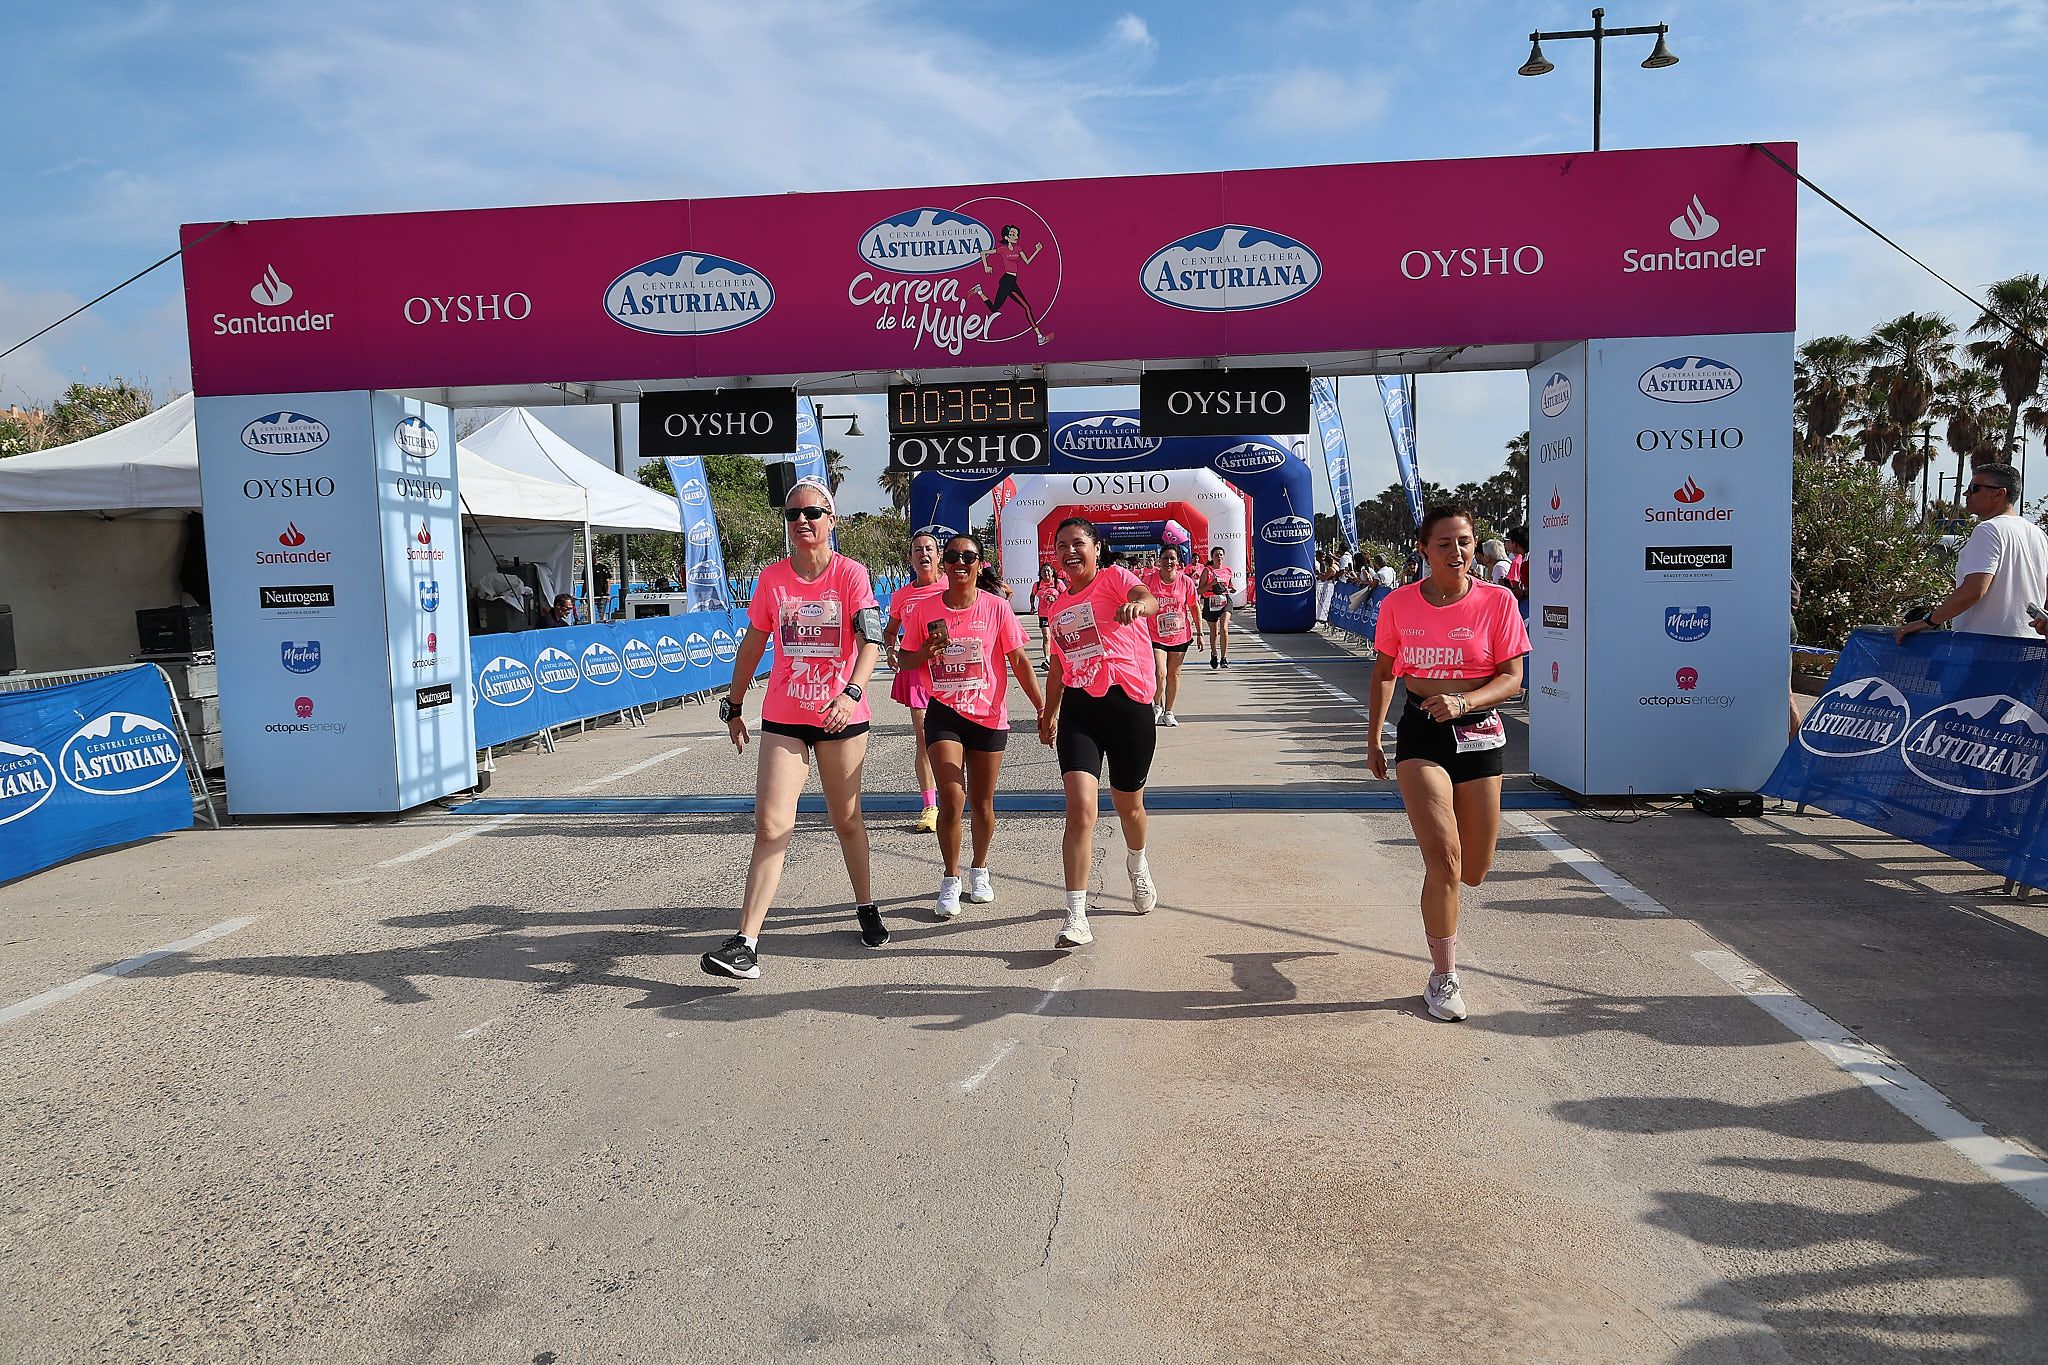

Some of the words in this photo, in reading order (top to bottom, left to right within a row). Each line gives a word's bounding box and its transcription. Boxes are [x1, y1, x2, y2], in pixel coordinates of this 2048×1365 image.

[889, 230, 933, 239] CENTRAL
[935, 228, 979, 237] LECHERA
[868, 234, 983, 259] ASTURIANA
[1181, 255, 1238, 266] CENTRAL
[1244, 252, 1301, 262] LECHERA
[1400, 245, 1545, 280] OYSHO
[1623, 244, 1766, 273] Santander
[642, 281, 694, 291] CENTRAL
[701, 278, 755, 288] LECHERA
[1154, 260, 1308, 292] ASTURIANA
[848, 271, 960, 305] Carrera
[403, 292, 532, 326] OYSHO
[618, 285, 762, 315] ASTURIANA
[213, 311, 334, 335] Santander
[876, 306, 897, 330] de
[901, 305, 916, 330] la
[913, 297, 1002, 356] Mujer
[1646, 374, 1735, 392] ASTURIANA
[899, 386, 1035, 425] 00:36:32
[1167, 390, 1286, 415] OYSHO
[664, 411, 774, 437] OYSHO
[248, 428, 324, 445] ASTURIANA
[398, 428, 436, 450] ASTURIANA
[1062, 430, 1155, 450] ASTURIANA
[1636, 427, 1744, 451] OYSHO
[897, 433, 1042, 467] OYSHO
[1540, 436, 1572, 464] OYSHO
[1221, 453, 1282, 468] ASTURIANA
[243, 476, 335, 499] OYSHO
[396, 477, 443, 500] OYSHO
[1072, 473, 1170, 496] OYSHO
[1016, 499, 1045, 507] OYSHO
[1197, 491, 1227, 500] OYSHO
[1083, 503, 1111, 513] Sports
[1123, 501, 1168, 510] Santander
[1645, 507, 1733, 523] Santander
[1005, 538, 1032, 546] OYSHO
[1265, 526, 1312, 538] ASTURIANA
[256, 550, 331, 565] Santander
[406, 547, 445, 561] Santander
[1651, 551, 1727, 568] Neutrogena
[264, 590, 330, 605] Neutrogena
[798, 626, 822, 636] 016
[1667, 613, 1709, 633] Marlene
[283, 647, 320, 666] Marlene
[1403, 647, 1464, 665] CARRERA
[540, 667, 579, 684] ASTURIANA
[585, 660, 620, 677] ASTURIANA
[807, 663, 821, 684] LA
[945, 664, 966, 673] 016
[485, 675, 533, 698] ASTURIANA
[787, 679, 830, 701] MUJER
[418, 690, 451, 705] Neutrogena
[1638, 695, 1691, 708] octopus
[1692, 695, 1736, 708] energy
[1829, 701, 1862, 713] CENTRAL
[1862, 706, 1900, 719] LECHERA
[265, 722, 309, 735] octopus
[310, 722, 347, 735] energy
[1803, 703, 1895, 745] ASTURIANA
[87, 739, 127, 754] CENTRAL
[129, 732, 168, 747] LECHERA
[1944, 720, 1990, 739] CENTRAL
[1993, 731, 2045, 751] LECHERA
[1907, 719, 2040, 781] ASTURIANA
[74, 743, 178, 783] ASTURIANA
